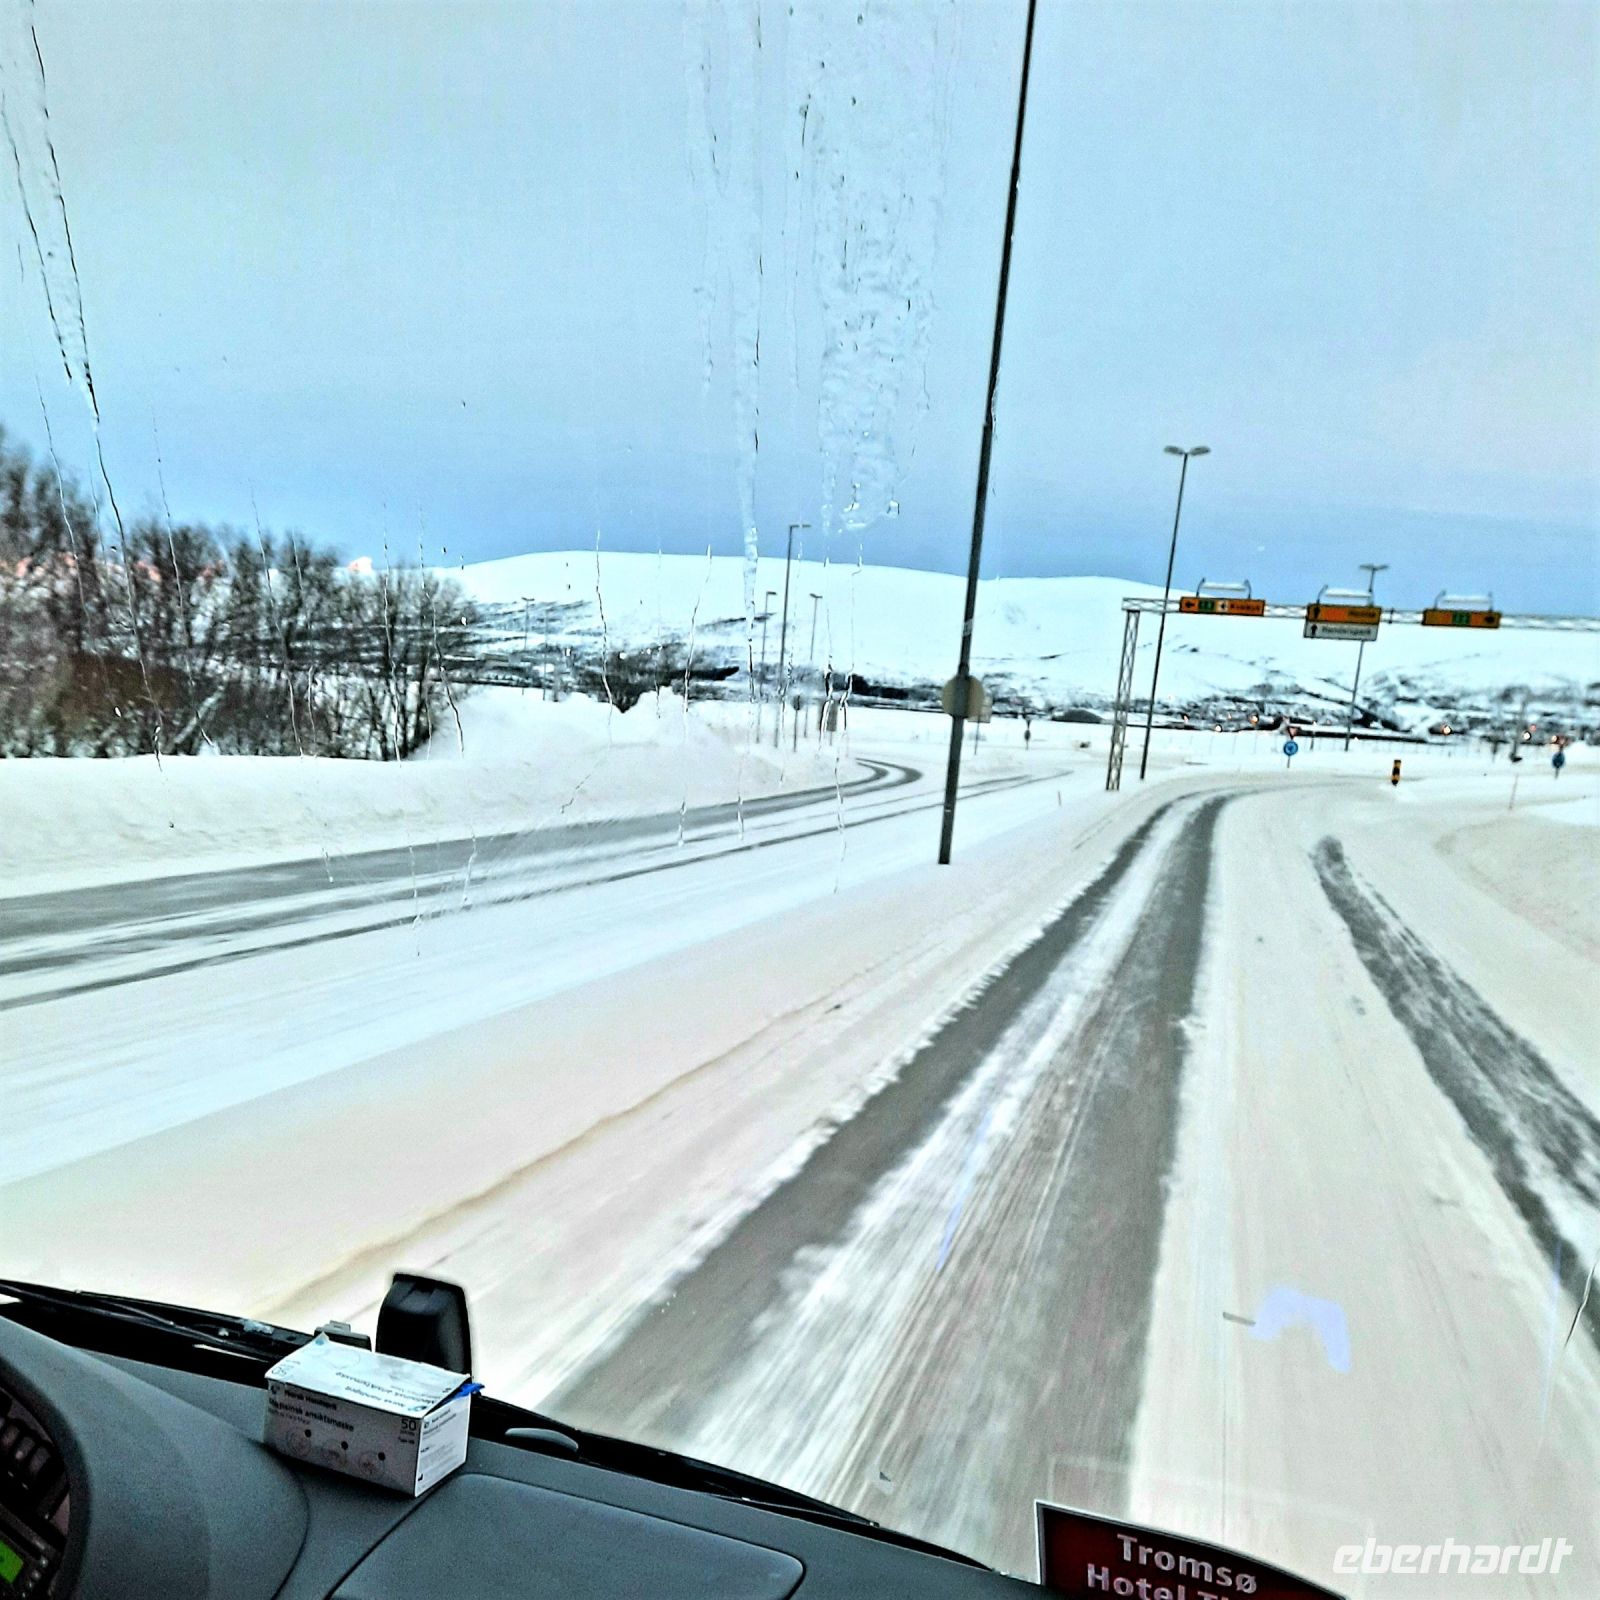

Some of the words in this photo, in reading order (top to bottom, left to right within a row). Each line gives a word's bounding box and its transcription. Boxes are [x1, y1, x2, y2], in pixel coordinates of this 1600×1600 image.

[401, 1418, 417, 1431] 50
[1087, 1563, 1186, 1600] Hotel
[1116, 1532, 1257, 1594] Tromsø
